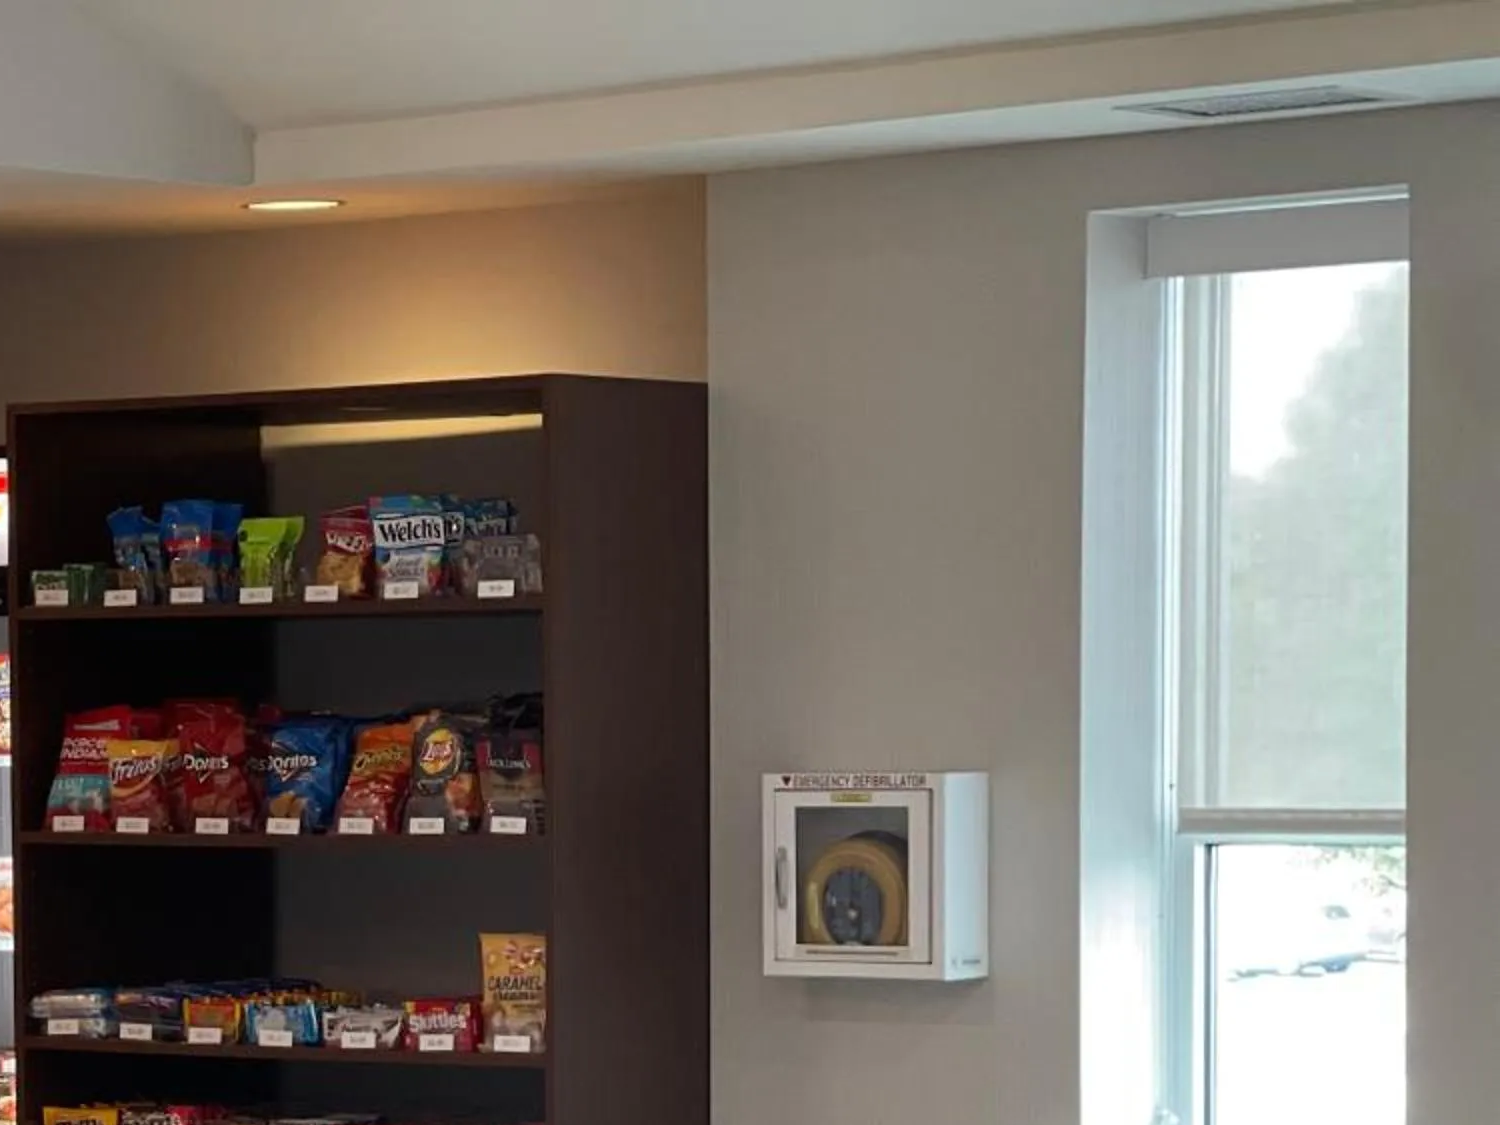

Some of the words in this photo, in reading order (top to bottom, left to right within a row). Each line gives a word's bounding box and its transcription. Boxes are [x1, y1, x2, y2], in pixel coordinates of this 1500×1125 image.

[379, 518, 441, 542] Welch's
[793, 775, 850, 788] EMERGENCY
[852, 774, 927, 788] DEFIBRILLATOR
[409, 1010, 468, 1033] Skittles
